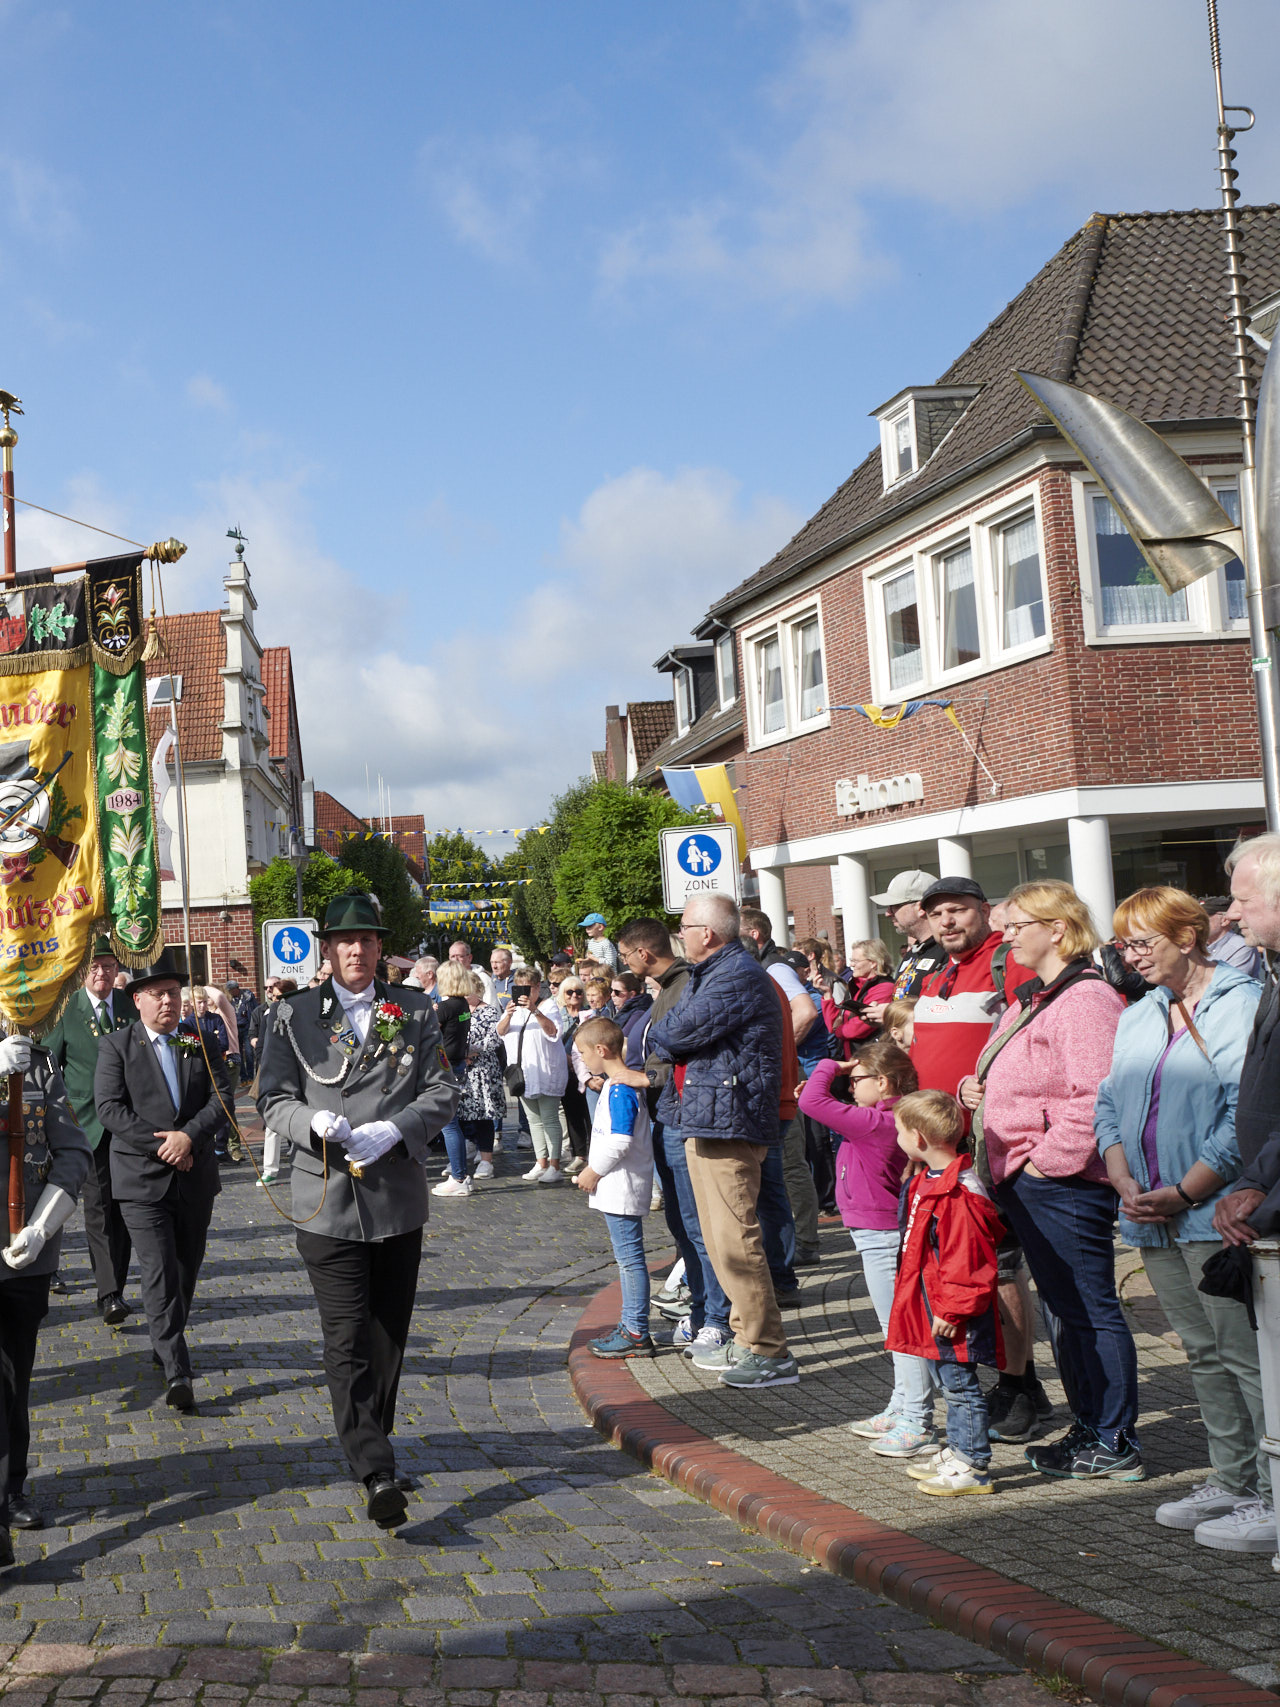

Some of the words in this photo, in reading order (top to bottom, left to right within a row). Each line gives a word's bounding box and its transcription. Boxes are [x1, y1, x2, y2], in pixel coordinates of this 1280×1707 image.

[108, 788, 141, 809] 1984
[684, 878, 718, 891] ZONE
[281, 965, 304, 973] ZONE
